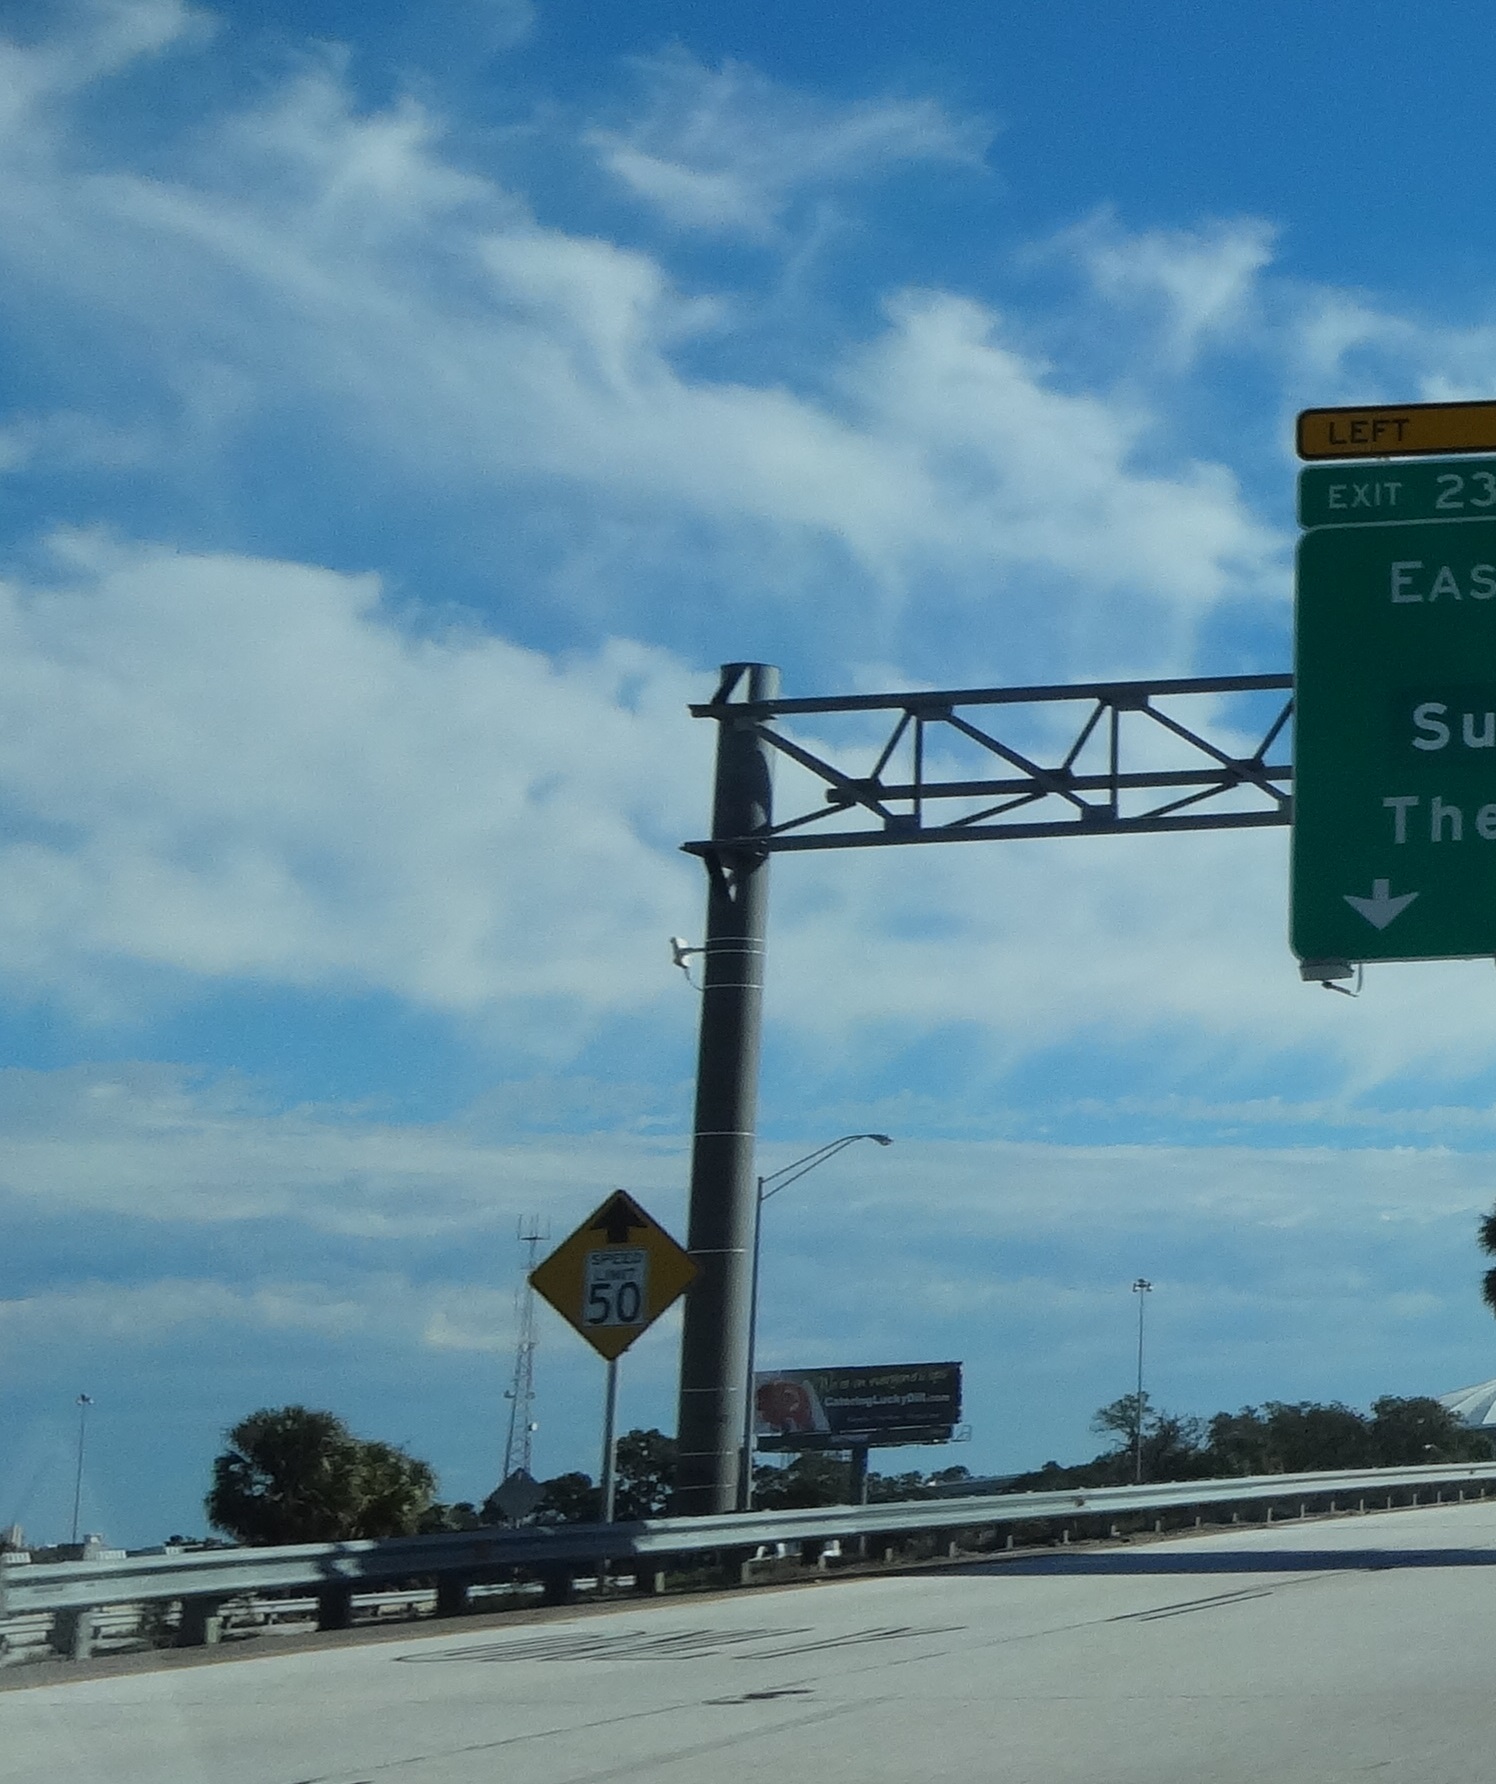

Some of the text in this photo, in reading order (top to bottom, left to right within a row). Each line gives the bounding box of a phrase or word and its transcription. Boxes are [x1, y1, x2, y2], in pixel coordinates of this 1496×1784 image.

[1328, 418, 1410, 445] LEFT
[1328, 482, 1402, 510] EXIT
[588, 1281, 641, 1324] 50
